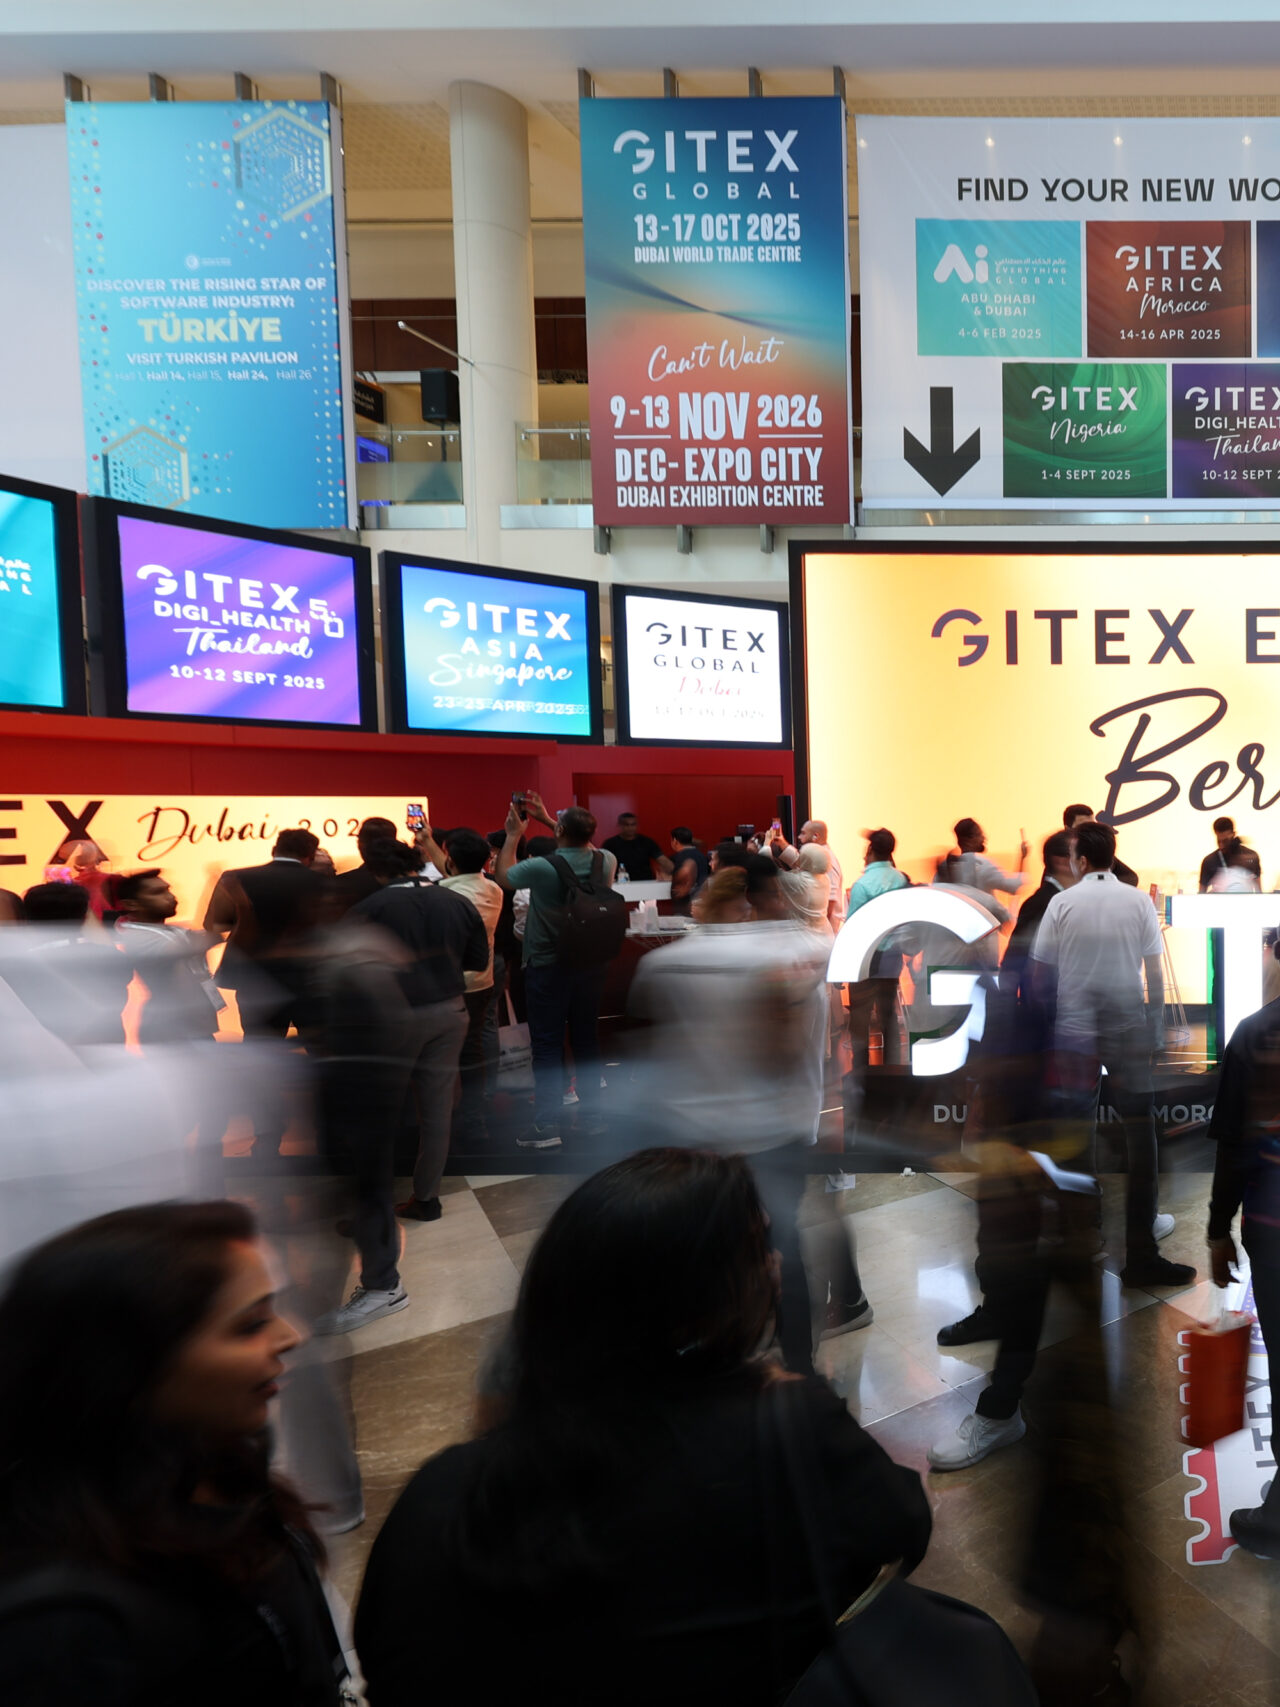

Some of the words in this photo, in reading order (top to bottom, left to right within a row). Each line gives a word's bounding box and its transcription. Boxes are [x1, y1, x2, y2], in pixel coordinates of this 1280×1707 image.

[613, 129, 799, 174] GITEX
[633, 182, 800, 200] GLOBAL
[957, 178, 1028, 201] FIND
[1041, 178, 1129, 202] YOUR
[1142, 178, 1215, 202] NEW
[635, 213, 695, 242] 13-17
[701, 213, 741, 241] OCT
[746, 213, 801, 242] 2025
[634, 246, 670, 263] DUBAI
[673, 246, 714, 263] WORLD
[717, 245, 754, 262] TRADE
[758, 245, 801, 262] CENTRE
[1115, 244, 1223, 271] GITEX
[87, 278, 166, 292] DISCOVER
[170, 278, 201, 291] THE
[205, 278, 257, 291] RISING
[260, 277, 301, 290] STAR
[305, 277, 327, 290] OF
[995, 276, 1067, 285] GLOBAL
[1125, 276, 1223, 292] AFRICA
[120, 296, 208, 309] SOFTWARE
[961, 293, 988, 304] ABU
[993, 293, 1036, 305] DHABI
[973, 305, 983, 316] &
[985, 304, 1028, 317] DUBAI
[1139, 292, 1211, 319] Morocco
[138, 309, 282, 343] TÜRKİYE
[957, 327, 980, 338] 4-6
[983, 327, 1007, 339] FEB
[1011, 327, 1042, 339] 2025
[1119, 328, 1156, 341] 14-16
[1160, 328, 1186, 341] APR
[1190, 328, 1221, 341] 2025
[126, 352, 163, 365] VISIT
[166, 352, 227, 364] TURKISH
[231, 351, 299, 364] PAVILION
[647, 342, 716, 382] Can't
[718, 335, 784, 371] Wait
[228, 369, 250, 380] Hall
[1031, 385, 1138, 411] GITEX
[610, 394, 670, 429] 9-13
[678, 391, 751, 441] NOV
[757, 394, 823, 428] 2026
[1050, 417, 1127, 445] Nigeria
[760, 446, 823, 482] CITY
[1041, 469, 1062, 481] 1-4
[1065, 469, 1097, 481] SEPT
[1101, 469, 1132, 481] 2025
[1202, 468, 1239, 481] 10-12
[1242, 468, 1273, 481] SEPT
[616, 485, 666, 508] DUBAI
[669, 485, 759, 508] EXHIBITION
[762, 484, 824, 507] CENTRE
[137, 564, 300, 614] GITEX
[154, 600, 311, 634] DIGI_HEALTH
[424, 597, 572, 641] GITEX
[173, 626, 313, 660] Thailand
[460, 636, 544, 662] ASIA
[645, 621, 766, 654] GITEX
[930, 605, 1196, 668] GITEX
[170, 664, 227, 682] 10-12
[232, 670, 278, 686] SEPT
[283, 674, 326, 690] 2025
[428, 653, 573, 687] Singapore
[653, 654, 760, 674] GLOBAL
[137, 806, 280, 862] Dubai
